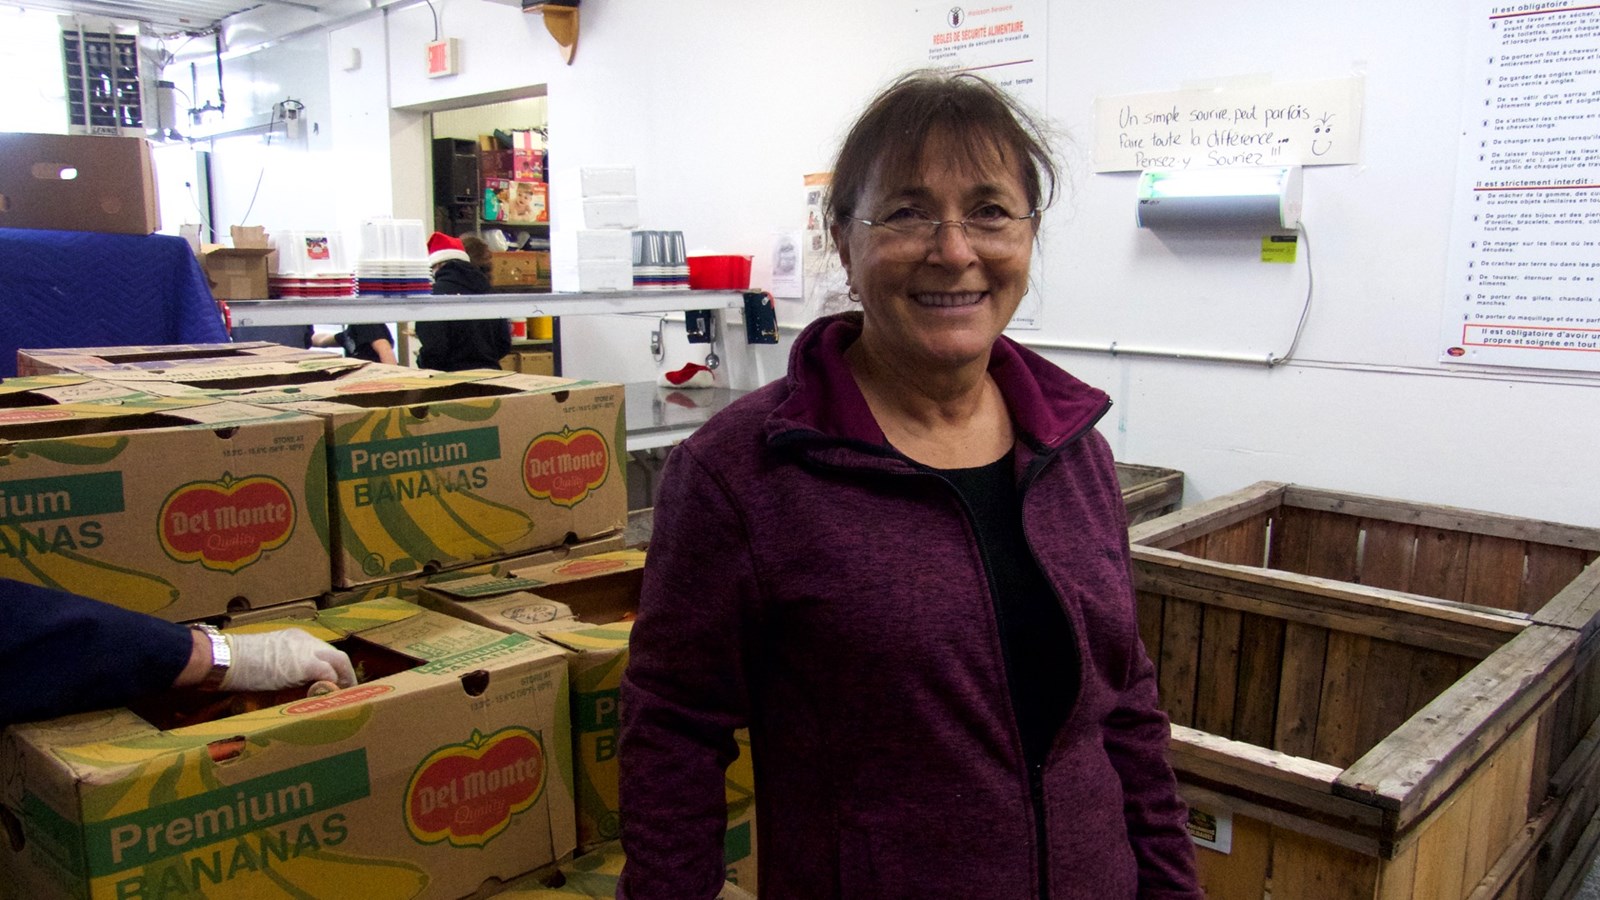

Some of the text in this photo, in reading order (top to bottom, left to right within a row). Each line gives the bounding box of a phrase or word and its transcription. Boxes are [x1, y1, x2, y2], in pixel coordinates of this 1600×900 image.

[1518, 1, 1567, 11] obligatoire
[962, 26, 987, 41] SÉCURITÉ
[988, 21, 1024, 37] ALIMENTAIRE
[1537, 20, 1577, 28] commencer
[1574, 25, 1599, 33] chaque
[1119, 106, 1139, 128] Un
[1145, 105, 1180, 124] simple
[1234, 109, 1257, 126] peut
[1265, 105, 1310, 127] parfois
[1152, 134, 1181, 146] toute
[1191, 130, 1200, 145] la
[1208, 151, 1263, 166] Souriez
[1506, 330, 1553, 338] obligatoire
[351, 441, 468, 473] Premium
[530, 450, 603, 478] Del Monte
[354, 466, 488, 507] BANANAS
[553, 476, 584, 490] Quality
[171, 502, 287, 536] Del Monte
[207, 533, 255, 551] Quality
[418, 757, 537, 815] Del Monte
[110, 781, 314, 864] Premium
[116, 813, 348, 900] BANANAS
